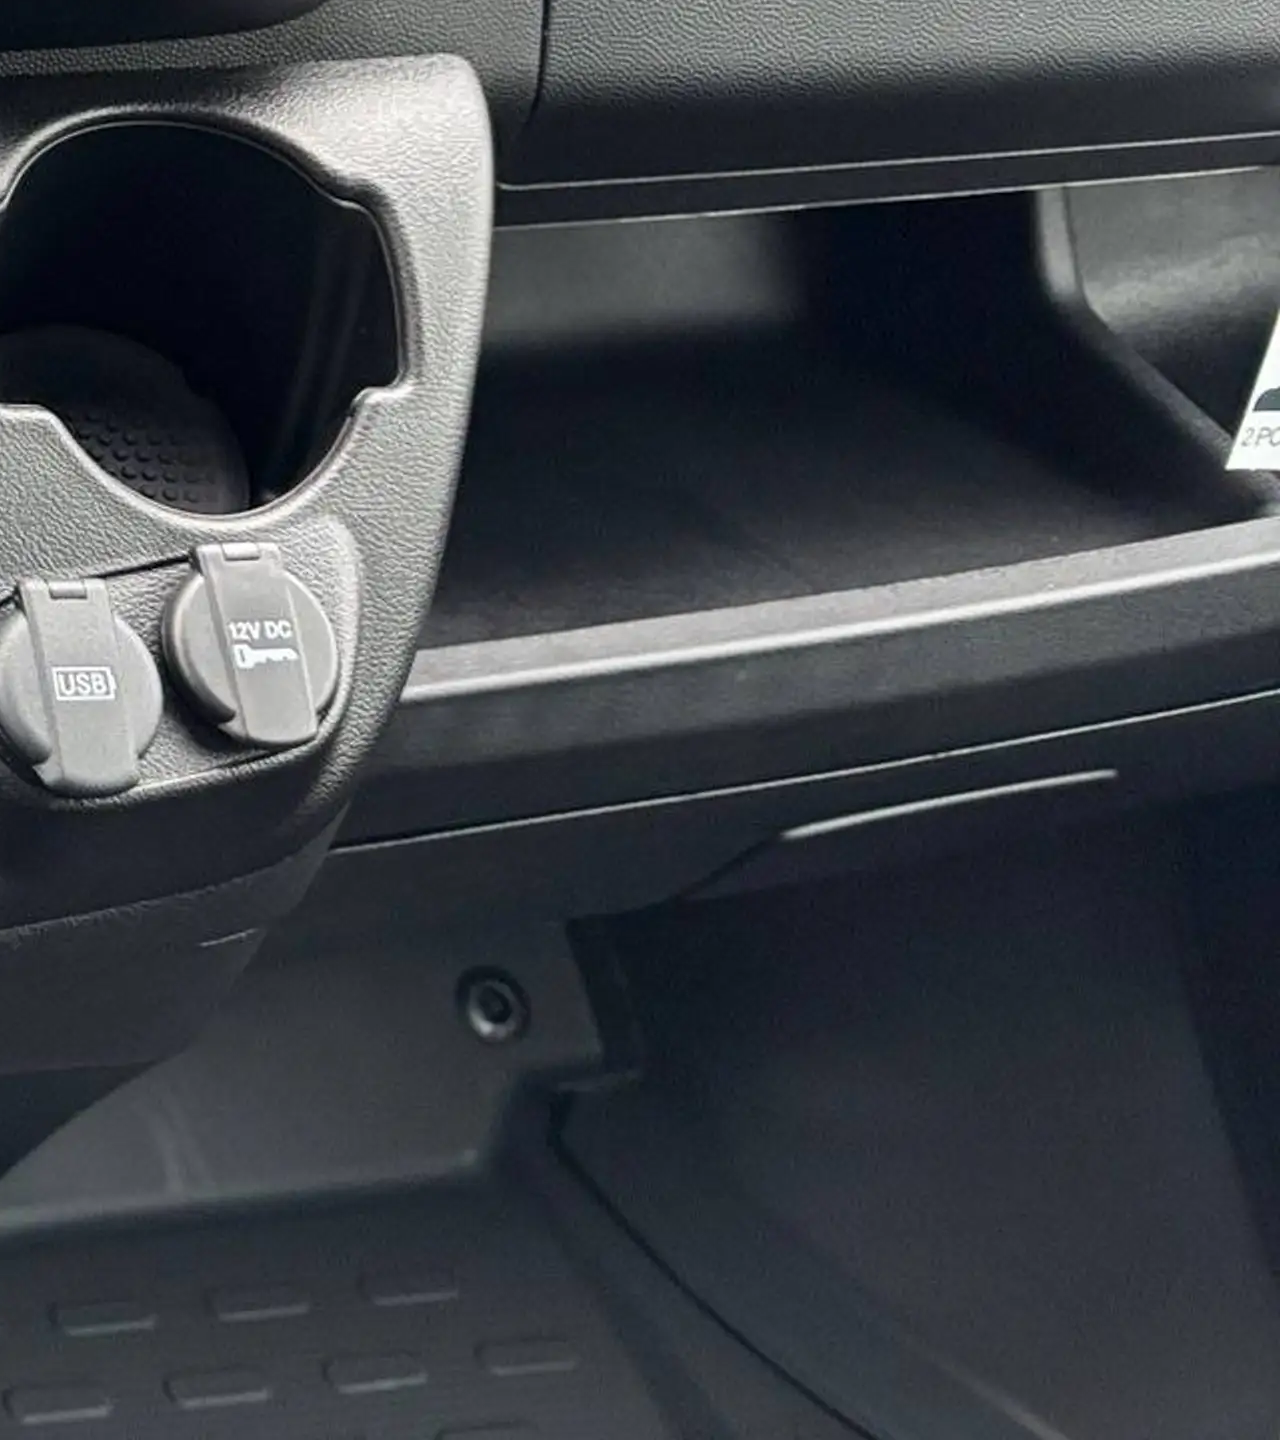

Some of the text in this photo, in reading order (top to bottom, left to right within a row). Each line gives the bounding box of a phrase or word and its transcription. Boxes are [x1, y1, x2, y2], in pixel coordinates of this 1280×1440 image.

[229, 620, 292, 641] 12V DC
[58, 672, 108, 695] USB
